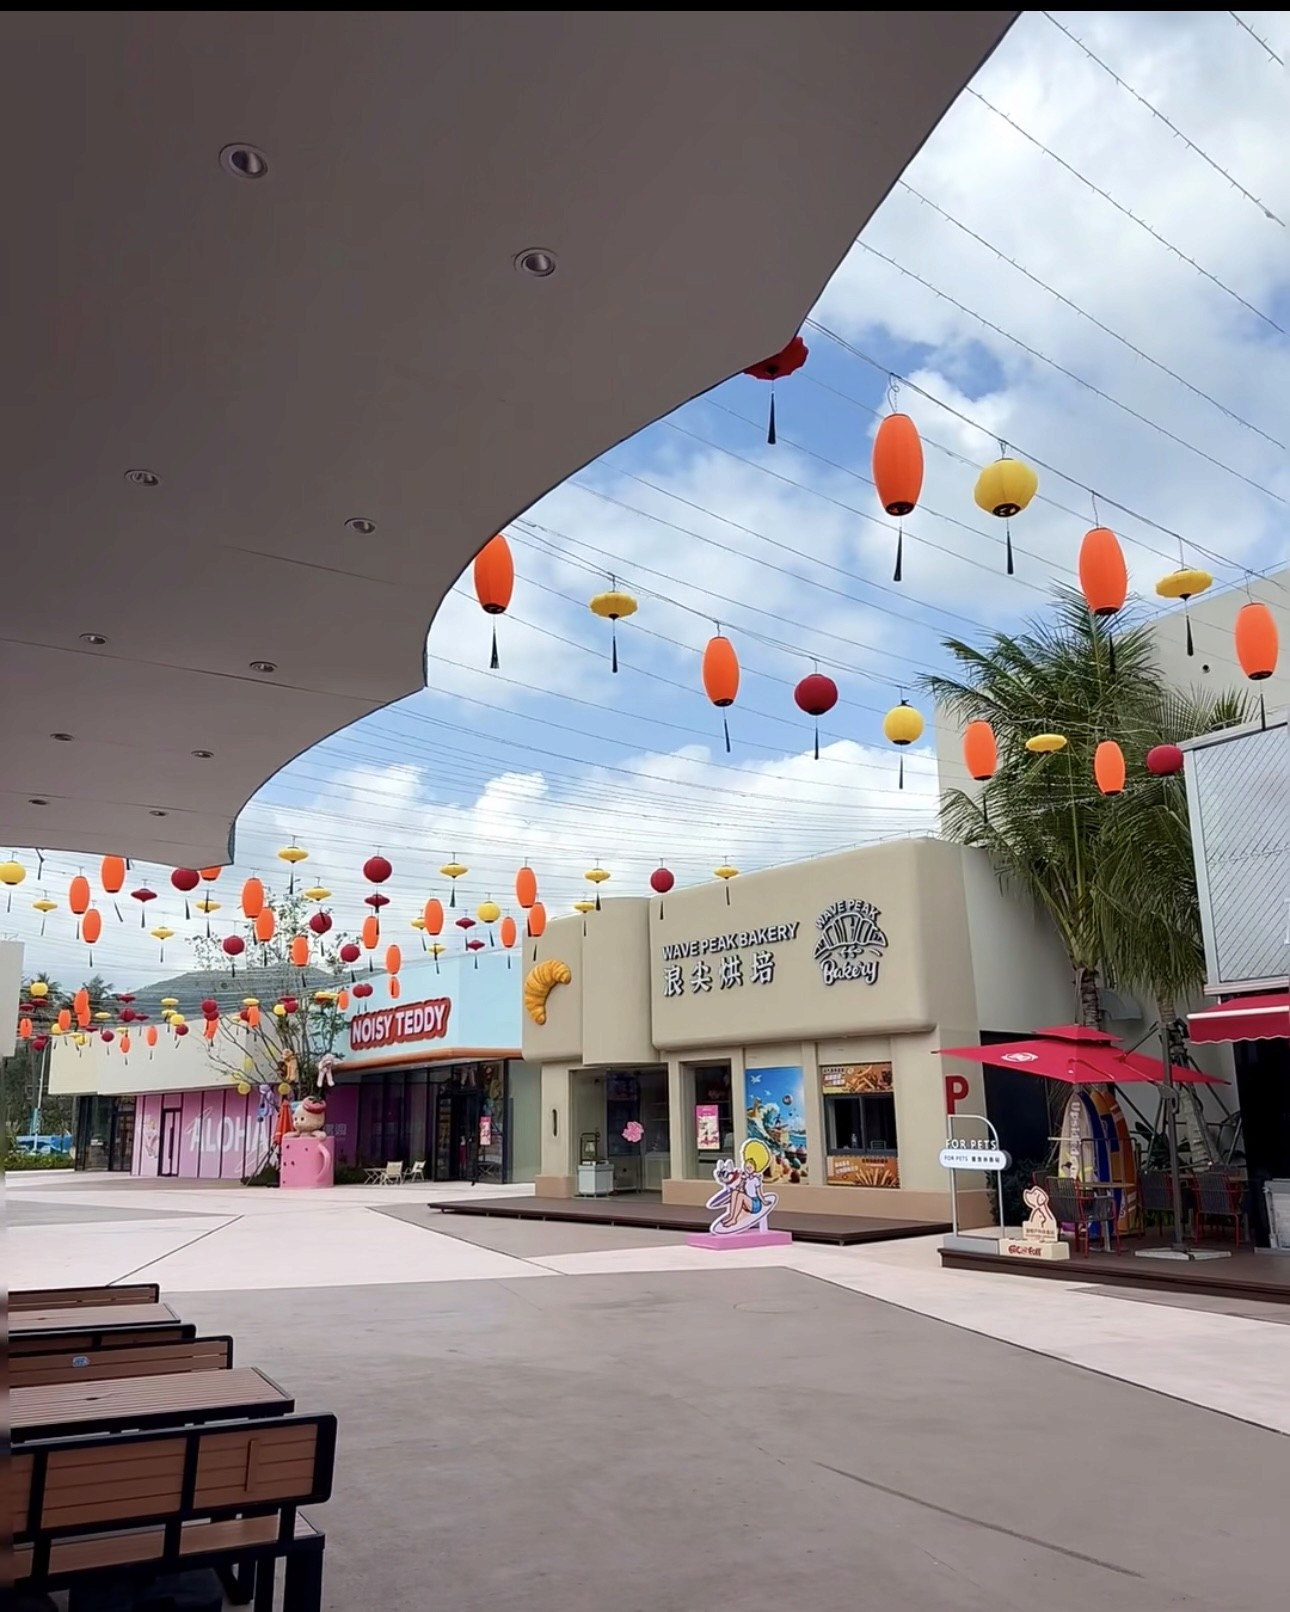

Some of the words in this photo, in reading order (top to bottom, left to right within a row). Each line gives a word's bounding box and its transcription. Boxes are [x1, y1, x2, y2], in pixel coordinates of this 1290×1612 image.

[815, 901, 847, 930] WAVE
[849, 899, 881, 921] PEAK
[662, 941, 700, 961] WAVE
[700, 933, 738, 955] PEAK
[739, 921, 799, 949] BAKERY
[821, 959, 879, 986] Bakery
[352, 1014, 393, 1043] NOISY
[395, 1004, 445, 1036] TEDDY
[945, 1075, 969, 1115] P
[189, 1115, 269, 1153] ALOHA
[945, 1139, 966, 1149] FOR
[970, 1140, 997, 1150] PETS
